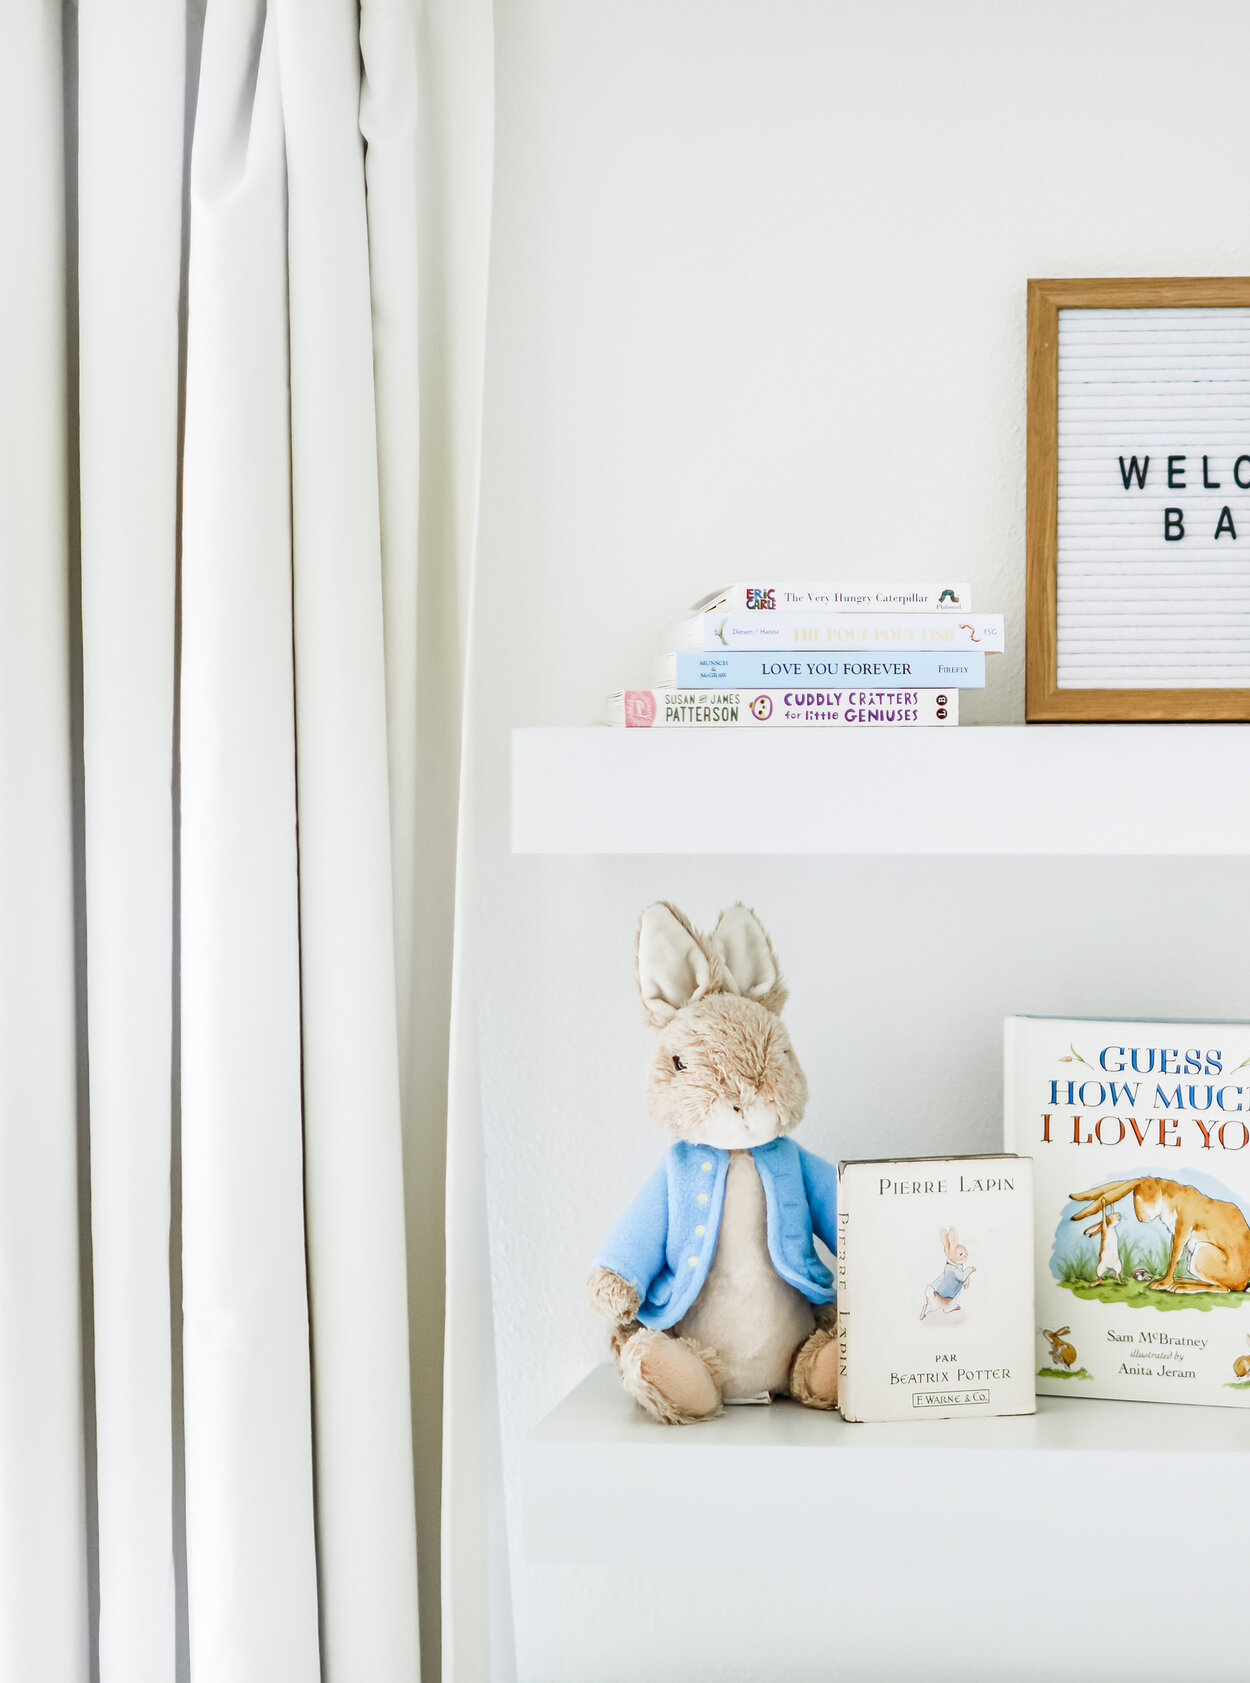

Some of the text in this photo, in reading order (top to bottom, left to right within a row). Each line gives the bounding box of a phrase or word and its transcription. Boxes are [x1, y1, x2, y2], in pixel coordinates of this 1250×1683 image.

[746, 599, 776, 610] CARLE
[785, 591, 929, 606] The Very Hungry Caterpillar
[792, 627, 818, 641] THE
[920, 627, 955, 642] FISH
[762, 663, 912, 676] LOVE YOU FOREVER
[665, 694, 695, 705] SUSAN
[710, 694, 740, 704] JAMES
[784, 692, 842, 707] CUDDLY
[665, 706, 739, 723] PATTERSON
[785, 709, 919, 723] for little GENIUSES
[1099, 1045, 1223, 1075] GUESS
[1048, 1079, 1141, 1108] HOW
[1040, 1113, 1053, 1143] I
[1069, 1115, 1182, 1148] LOVE
[1107, 1329, 1209, 1351] Sam McBratney
[935, 1353, 958, 1363] PAR
[1130, 1349, 1185, 1362] illustrated by
[1118, 1362, 1196, 1379] Anita Jeram
[964, 1394, 971, 1402] &
